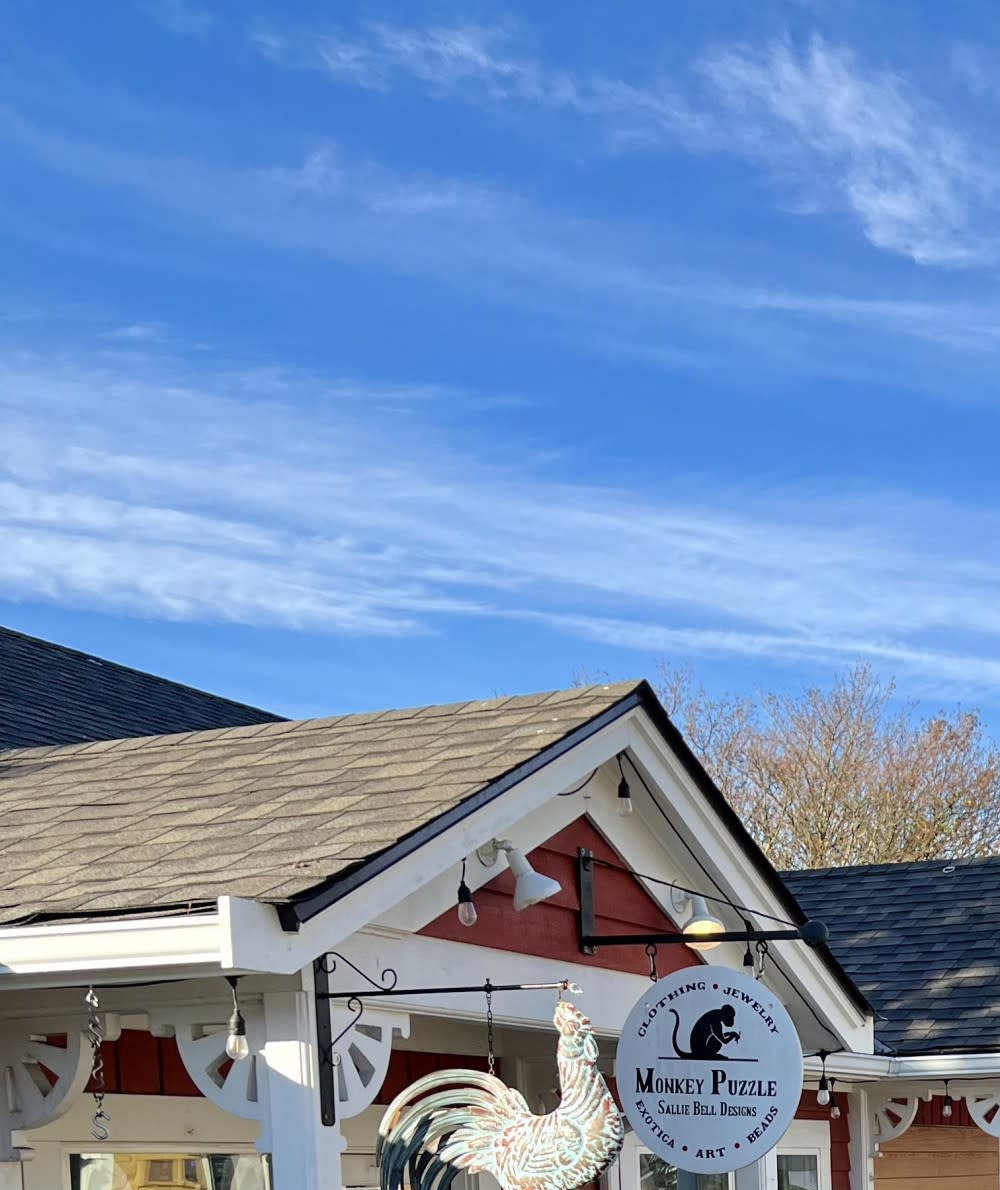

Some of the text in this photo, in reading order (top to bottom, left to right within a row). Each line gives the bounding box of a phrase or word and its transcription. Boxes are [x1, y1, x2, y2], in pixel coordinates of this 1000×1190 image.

[637, 981, 780, 1038] CLOTHING JEWELRY
[635, 1099, 779, 1159] EXOTICA ART BEADS
